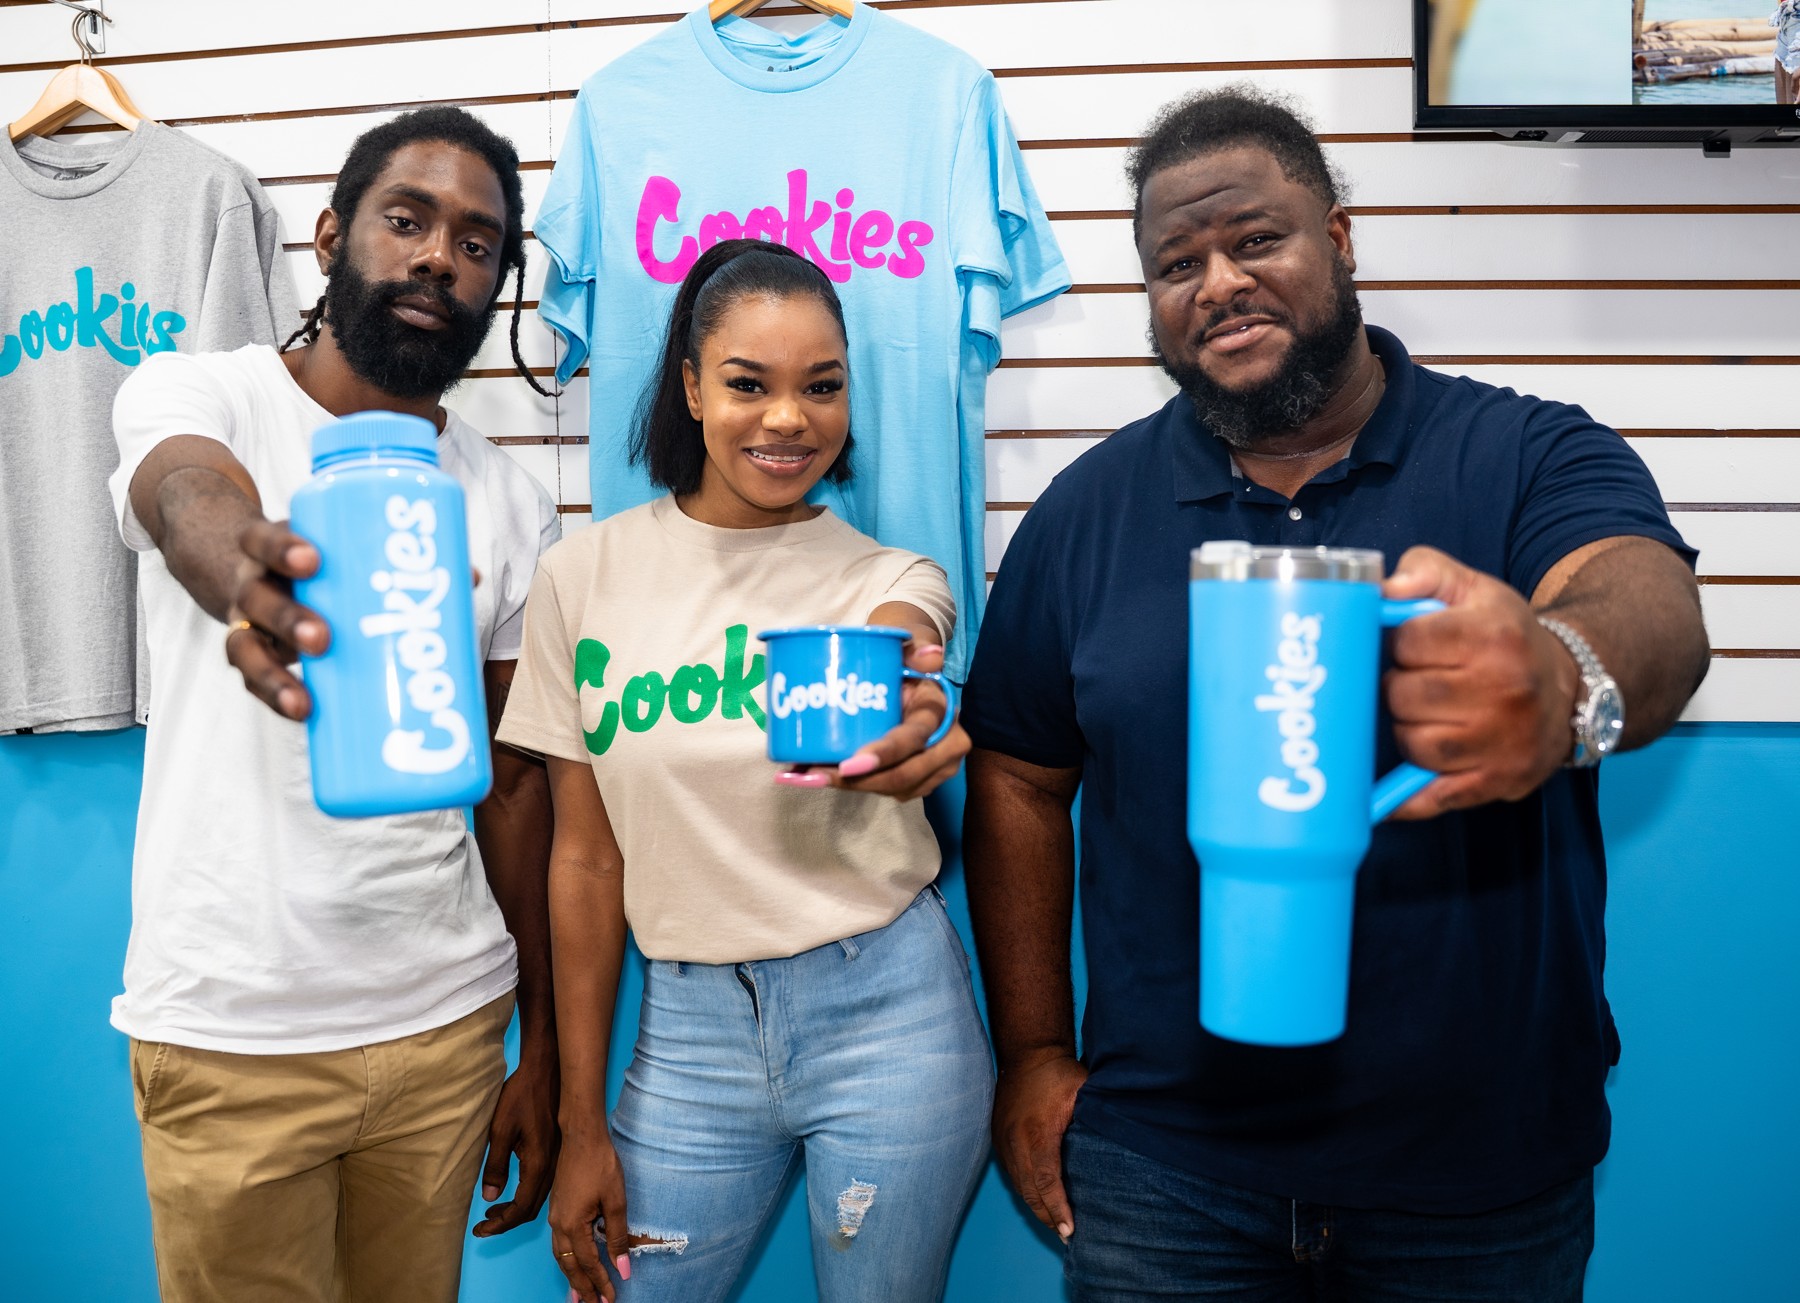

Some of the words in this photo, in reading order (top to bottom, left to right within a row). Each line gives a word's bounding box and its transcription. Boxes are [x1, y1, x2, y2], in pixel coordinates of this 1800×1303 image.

[360, 495, 470, 774] Cookies
[574, 624, 767, 755] Cook
[771, 667, 888, 719] Cookies
[1254, 611, 1327, 812] Cookies
